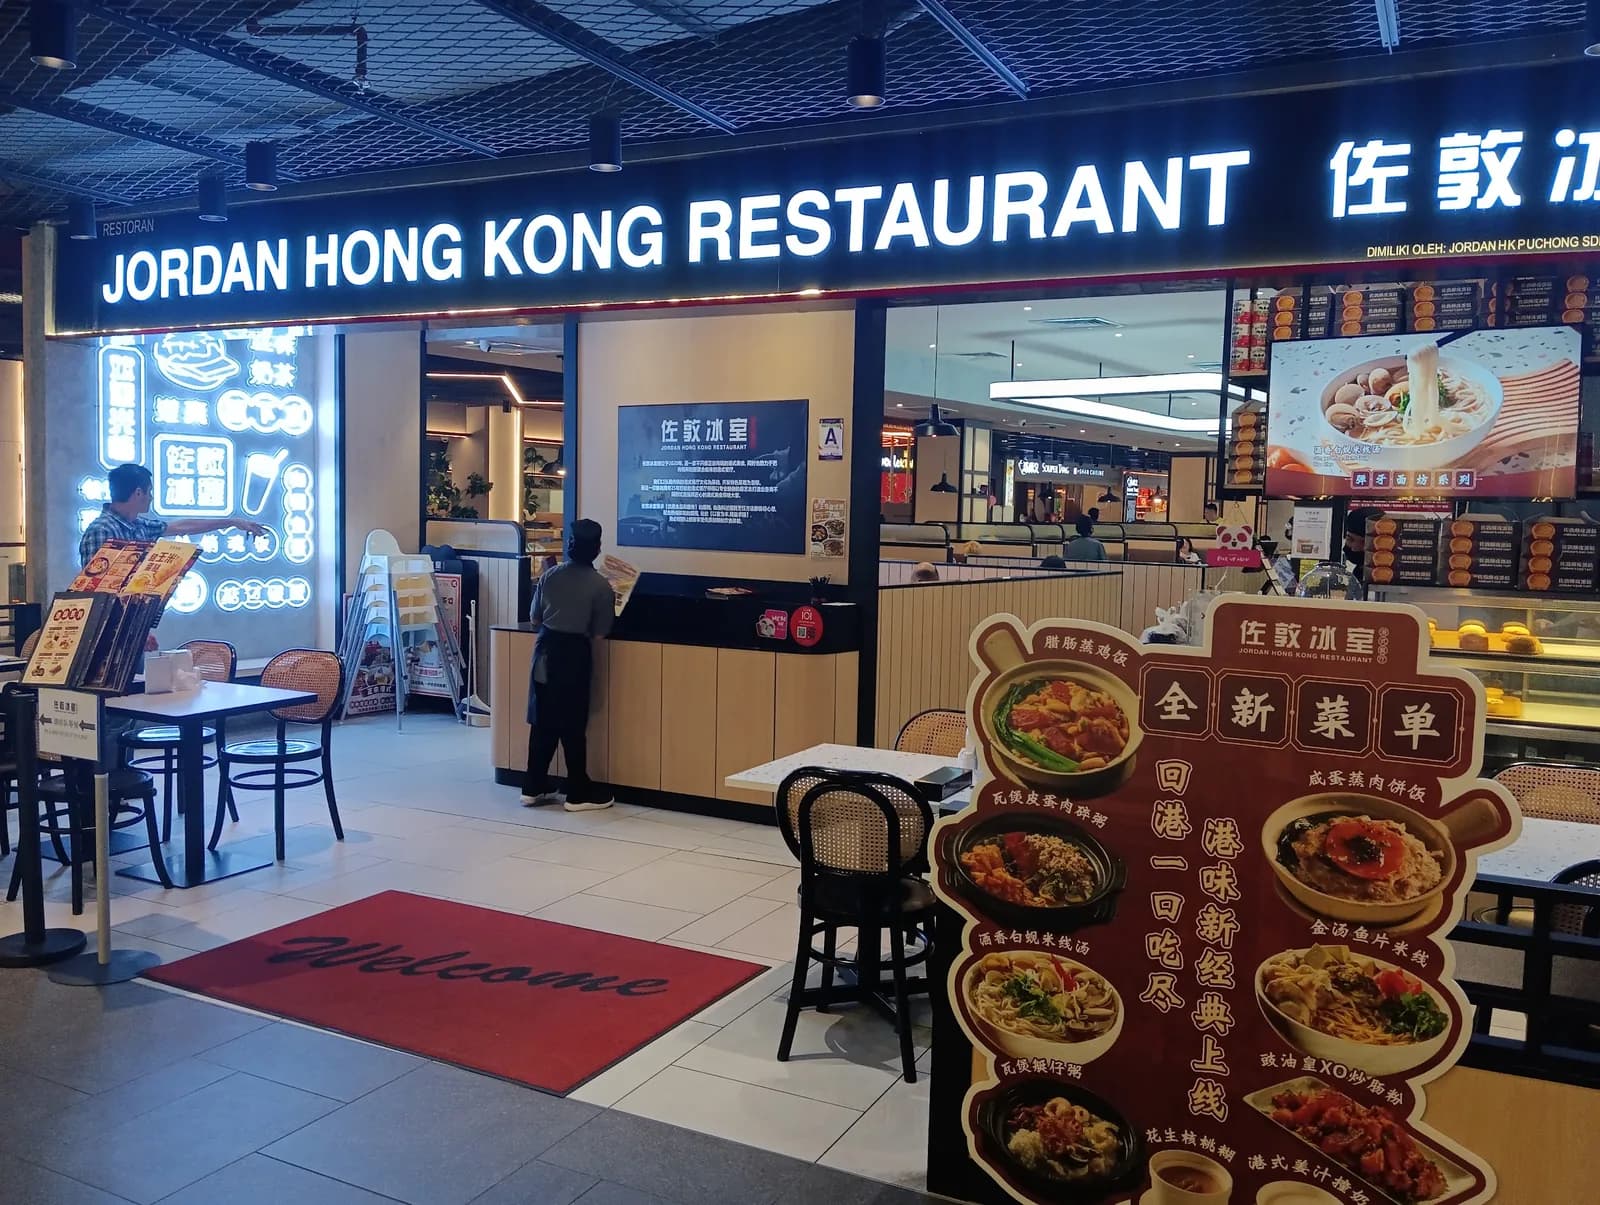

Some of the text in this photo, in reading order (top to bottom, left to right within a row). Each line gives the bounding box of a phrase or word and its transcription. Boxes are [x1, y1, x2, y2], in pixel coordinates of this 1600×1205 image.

[102, 218, 154, 237] RESTORAN
[103, 151, 1250, 303] JORDAN HONG KONG RESTAURANT
[1366, 235, 1600, 258] DIMILIKI OLEH: JORDAN HK PUCHONG SD
[661, 418, 748, 443] 佐敦冰室
[824, 428, 838, 444] A
[1043, 634, 1129, 668] 腊肠蒸鸡饭
[1240, 620, 1375, 655] 佐敦冰室
[1295, 652, 1318, 660] KONG
[1320, 653, 1373, 663] RESTAURANT
[1154, 680, 1441, 751] 全新菜单
[1308, 770, 1427, 803] 咸蛋蒸肉饼饭
[992, 790, 1110, 829] 瓦煲皮蛋肉碎粥
[1140, 759, 1193, 1013] 回港一回吃尽
[978, 930, 1091, 956] 酒香白蚬米线汤
[1310, 918, 1430, 967] 金汤鱼片米线
[267, 936, 669, 997] Welcome
[1188, 818, 1244, 1122] 港味新经典上线
[1145, 1127, 1236, 1164] 花生核桃糊
